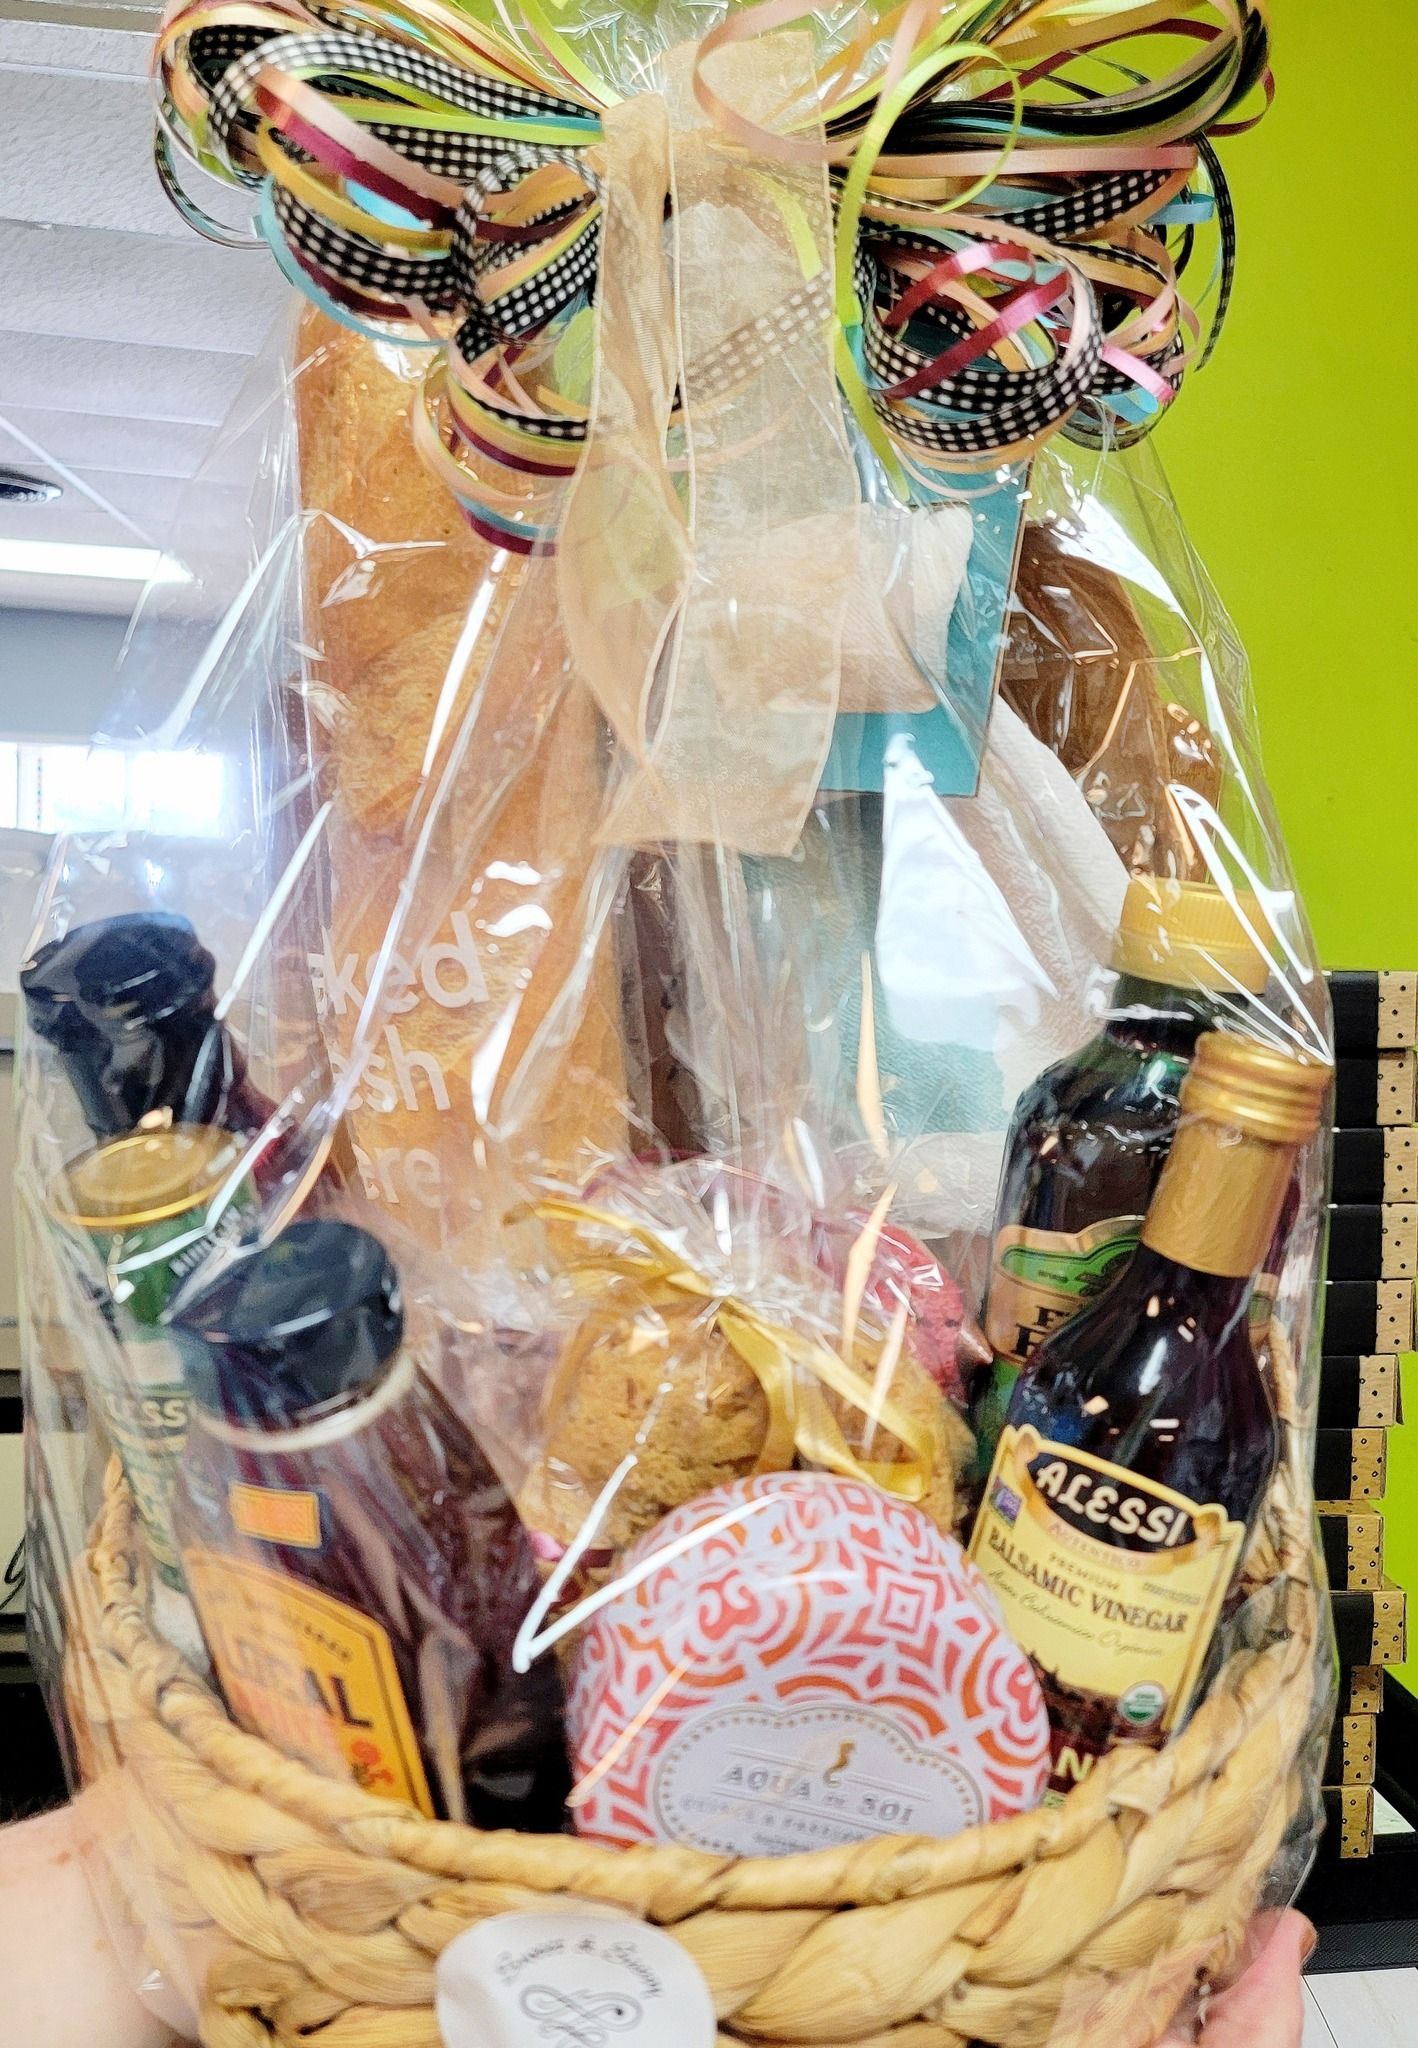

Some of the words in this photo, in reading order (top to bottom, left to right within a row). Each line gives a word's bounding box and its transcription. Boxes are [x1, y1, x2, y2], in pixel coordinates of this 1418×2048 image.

[307, 911, 490, 1016] ked
[1035, 1461, 1188, 1547] ALESSI
[988, 1526, 1085, 1607] BALSAMIC
[1091, 1592, 1189, 1633] VINEGAR
